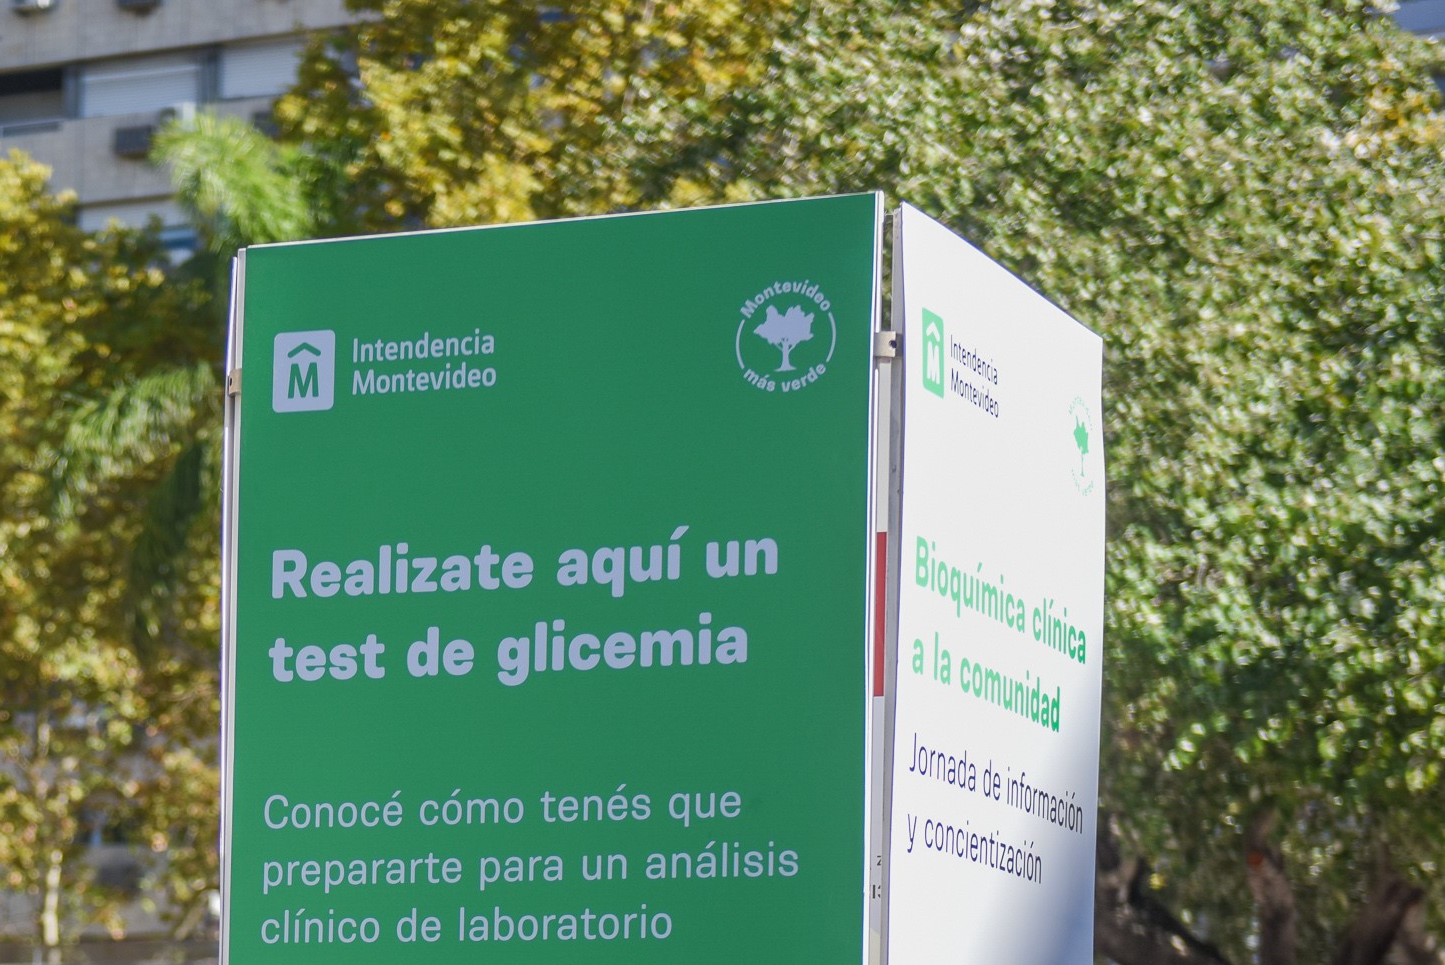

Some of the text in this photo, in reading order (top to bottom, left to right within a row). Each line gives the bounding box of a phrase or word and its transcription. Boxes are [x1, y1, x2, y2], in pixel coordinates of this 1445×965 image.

[740, 279, 831, 319] Montevideo
[352, 328, 495, 363] Intendencia
[950, 334, 997, 386] Intendencia
[353, 364, 496, 395] Montevideo
[743, 363, 827, 393] más verde
[950, 368, 999, 418] Montevideo
[272, 526, 778, 598] Realizate aquí un
[915, 535, 1086, 665] Bioquímica clínica
[269, 612, 747, 686] test de glicemia
[912, 632, 1061, 733] a la comunidad
[264, 784, 741, 829] Conocé cómo tenés que
[909, 732, 1084, 835] Jornada de información
[264, 841, 798, 894] prepararte para un análisis
[906, 812, 918, 854] y
[924, 817, 1043, 885] concientización
[261, 904, 672, 944] clínico de laboratorio
